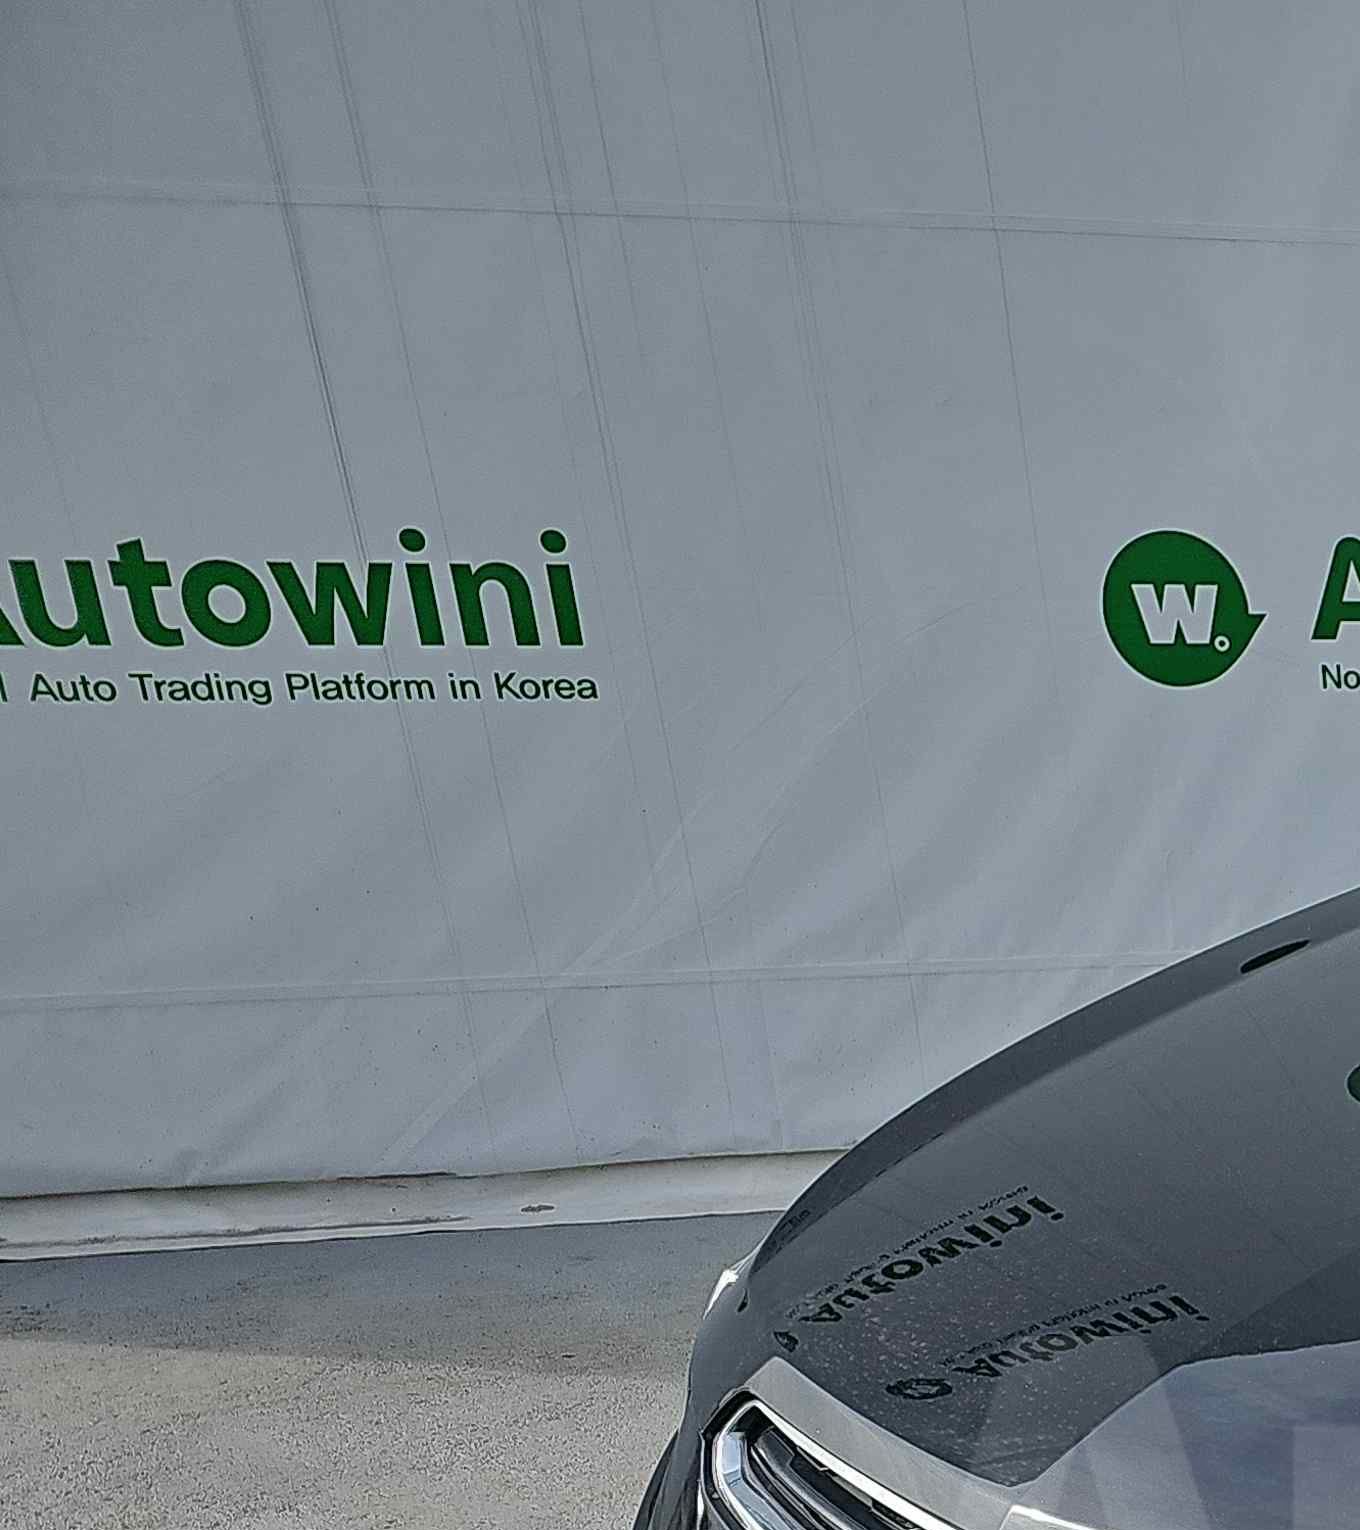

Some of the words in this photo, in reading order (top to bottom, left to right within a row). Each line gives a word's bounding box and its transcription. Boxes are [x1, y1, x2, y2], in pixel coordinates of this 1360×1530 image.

[0, 527, 585, 648] utowini
[30, 673, 117, 702] Auto
[128, 673, 272, 705] Trading
[285, 672, 436, 702] Platform
[448, 672, 481, 700] in
[494, 672, 598, 701] Korea
